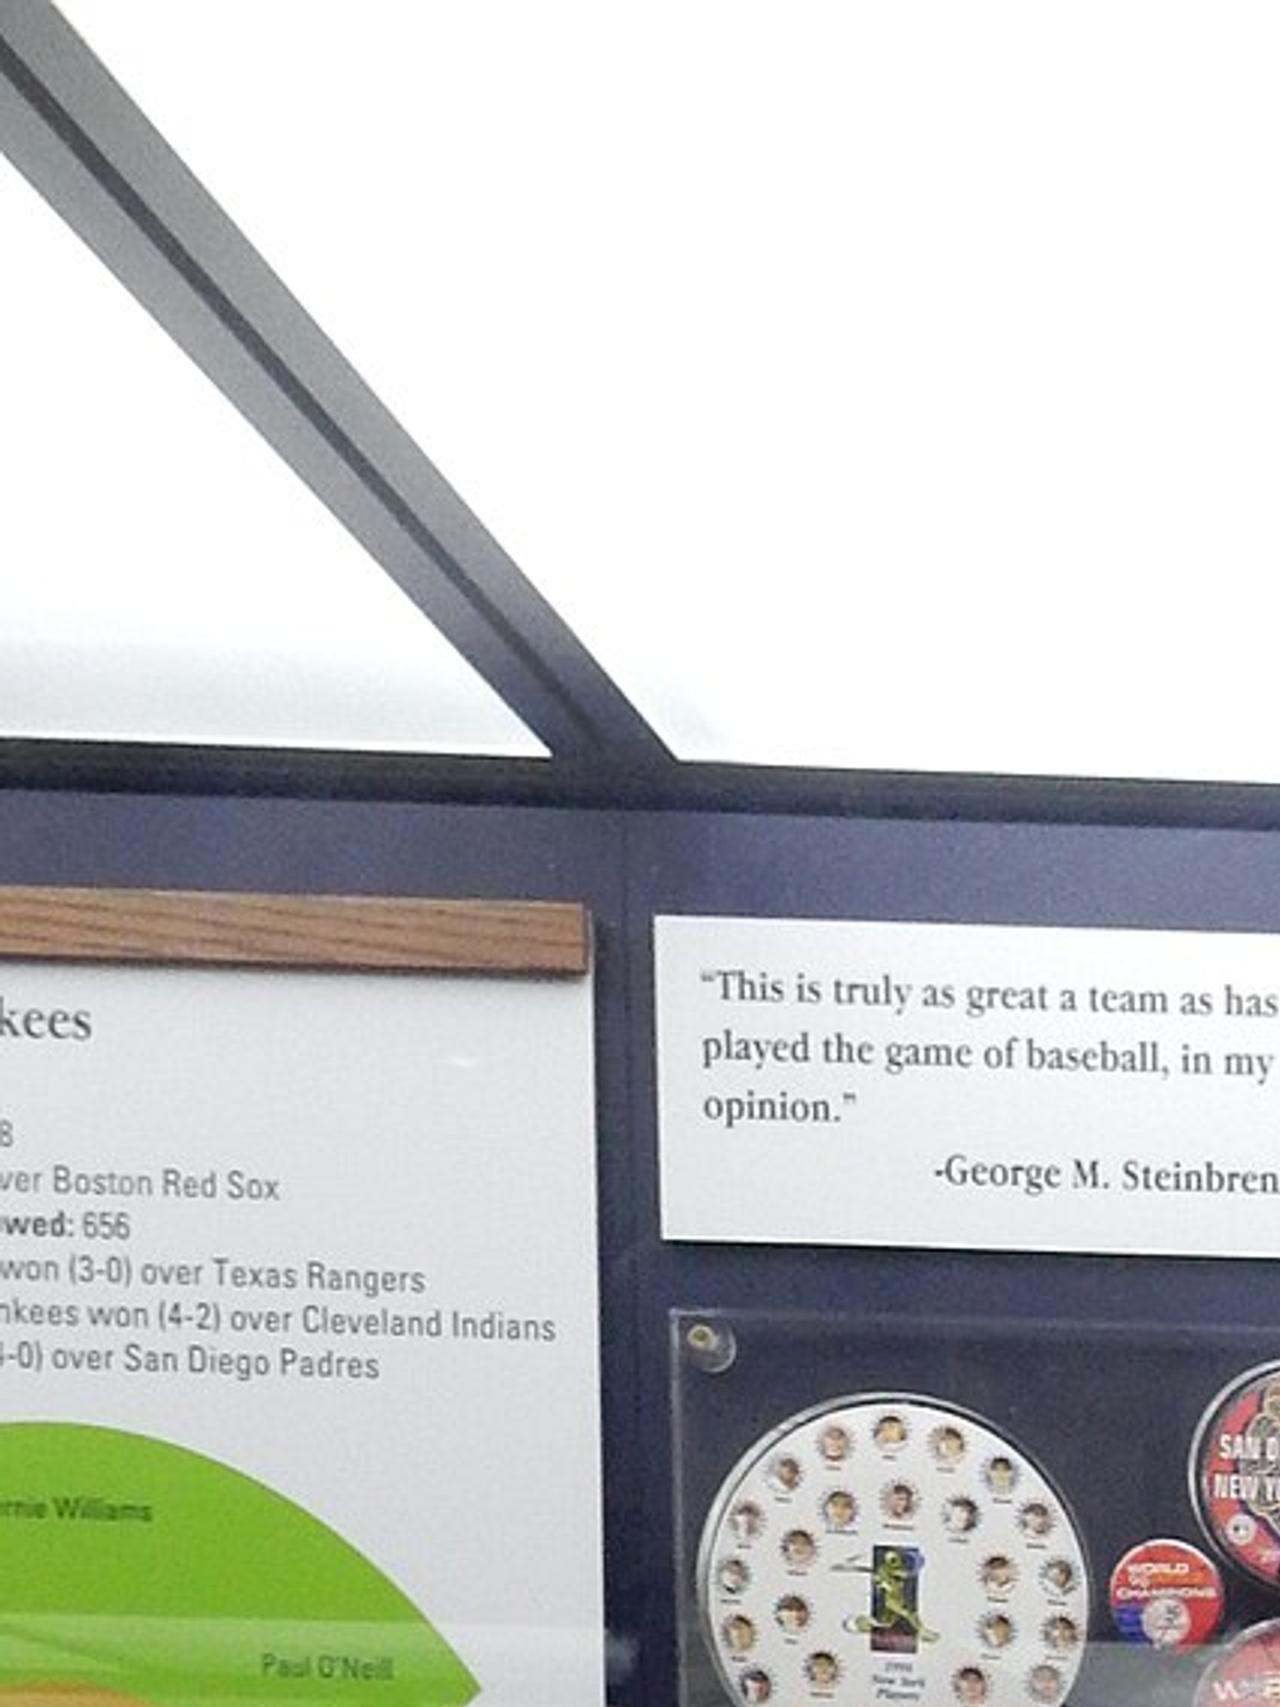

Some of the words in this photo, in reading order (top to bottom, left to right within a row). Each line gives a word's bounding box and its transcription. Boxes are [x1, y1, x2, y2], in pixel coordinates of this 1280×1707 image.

[797, 972, 821, 1004] is
[834, 974, 911, 1016] truly
[923, 984, 955, 1009] as
[966, 986, 1047, 1017] great
[1060, 989, 1076, 1012] a
[1089, 987, 1168, 1014] team
[1180, 992, 1212, 1016] as
[1225, 984, 1278, 1017] has
[703, 1029, 810, 1070] played
[823, 1032, 874, 1065] the
[885, 1043, 972, 1075] game
[984, 1036, 1019, 1069] of
[1027, 1037, 1168, 1076] baseball,
[1182, 1043, 1211, 1075] in
[1225, 1053, 1273, 1085] my
[53, 1164, 153, 1196] Boston
[163, 1168, 216, 1199] Red
[227, 1170, 279, 1201] Sox
[935, 1154, 1060, 1195] -George
[1074, 1159, 1109, 1189] M.
[0, 1210, 74, 1238] wed:
[83, 1211, 130, 1240] 656
[69, 1254, 132, 1287] (3-0)
[141, 1263, 203, 1286] over
[213, 1257, 297, 1290] Texas
[307, 1261, 425, 1298] Rangers
[88, 1306, 148, 1328] won
[159, 1301, 220, 1332] (4-2)
[231, 1310, 292, 1333] over
[303, 1305, 442, 1337] Cleveland
[453, 1311, 556, 1341] Indians
[52, 1348, 113, 1371] over
[124, 1342, 178, 1373] San
[188, 1344, 270, 1382] Diego
[280, 1347, 379, 1379] Padres
[1219, 1434, 1259, 1460] SAN
[1214, 1473, 1259, 1500] NEW
[261, 1655, 312, 1679] Paul
